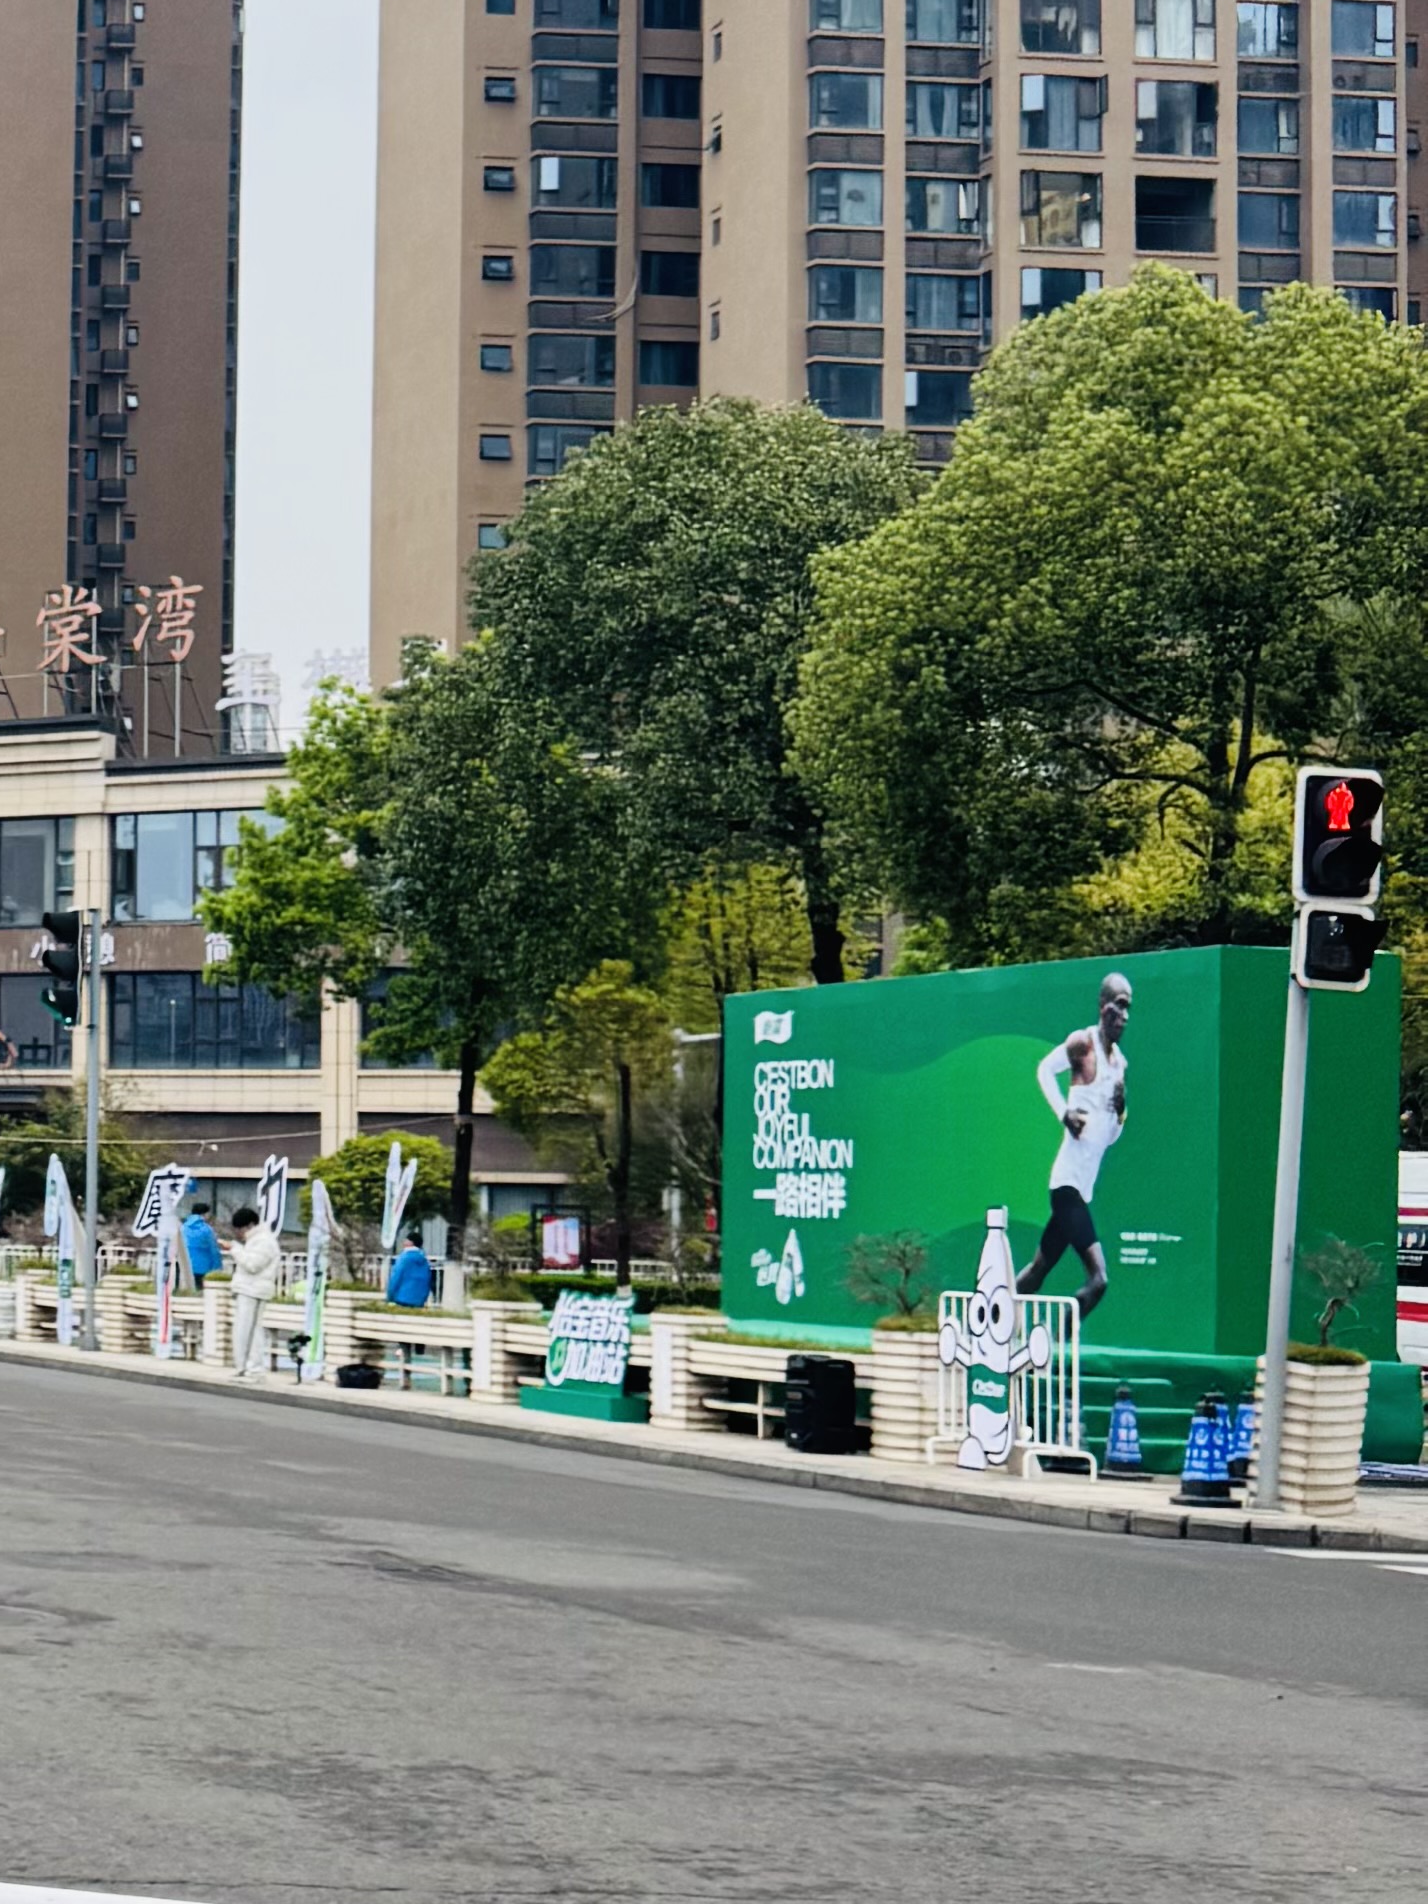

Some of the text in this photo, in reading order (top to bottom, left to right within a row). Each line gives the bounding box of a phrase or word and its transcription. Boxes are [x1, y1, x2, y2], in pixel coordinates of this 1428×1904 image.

[754, 1059, 834, 1089] CESTBON
[754, 1087, 790, 1118] OUR
[753, 1138, 854, 1169] COMPANION
